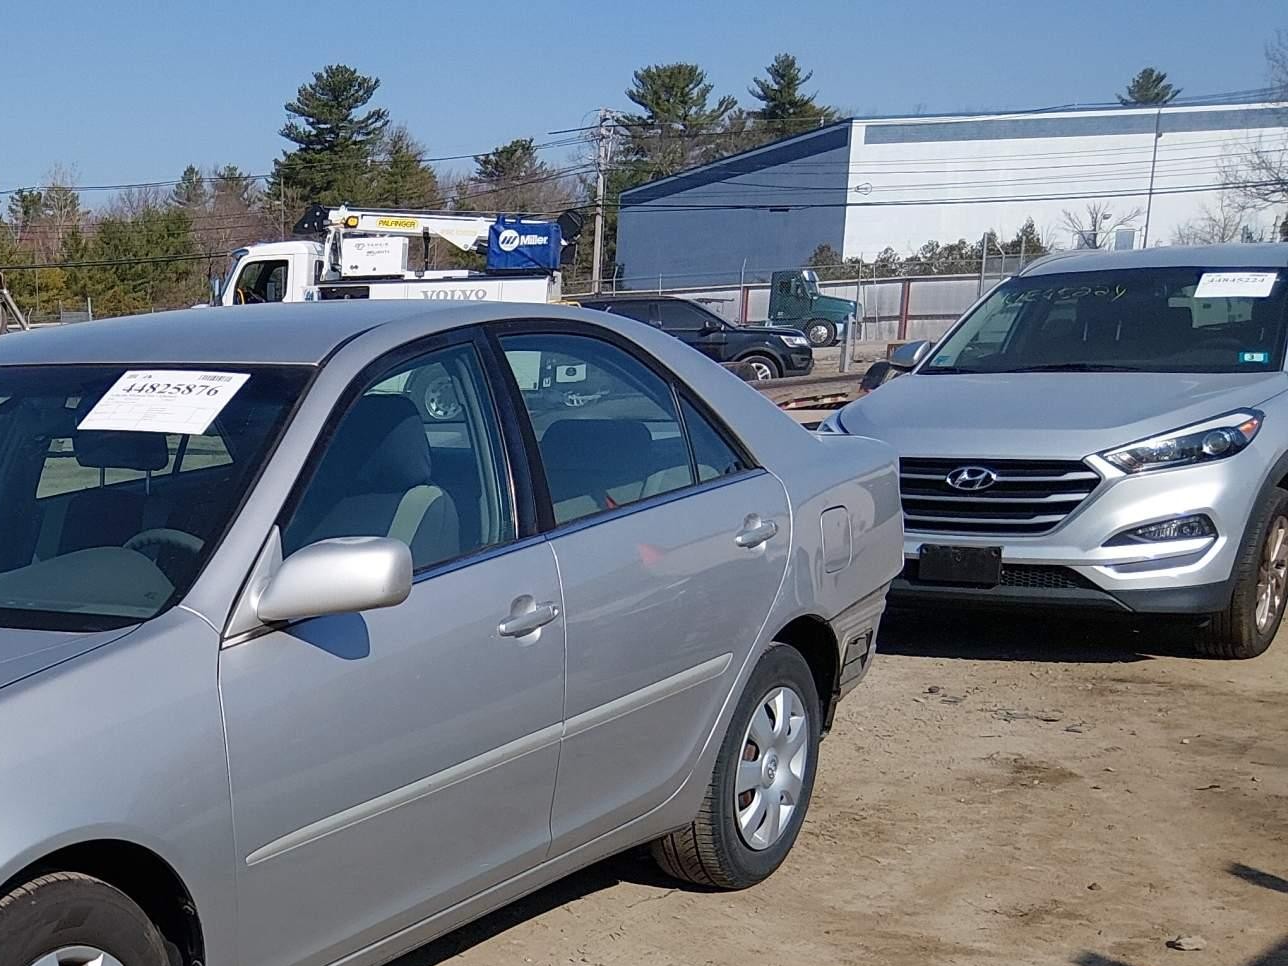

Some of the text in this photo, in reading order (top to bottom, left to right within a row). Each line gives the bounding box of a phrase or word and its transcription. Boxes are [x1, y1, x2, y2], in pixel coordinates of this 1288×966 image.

[378, 219, 416, 229] PALFINGER
[519, 234, 549, 245] Miller
[421, 289, 487, 300] VOLVO
[122, 382, 224, 396] 44825876
